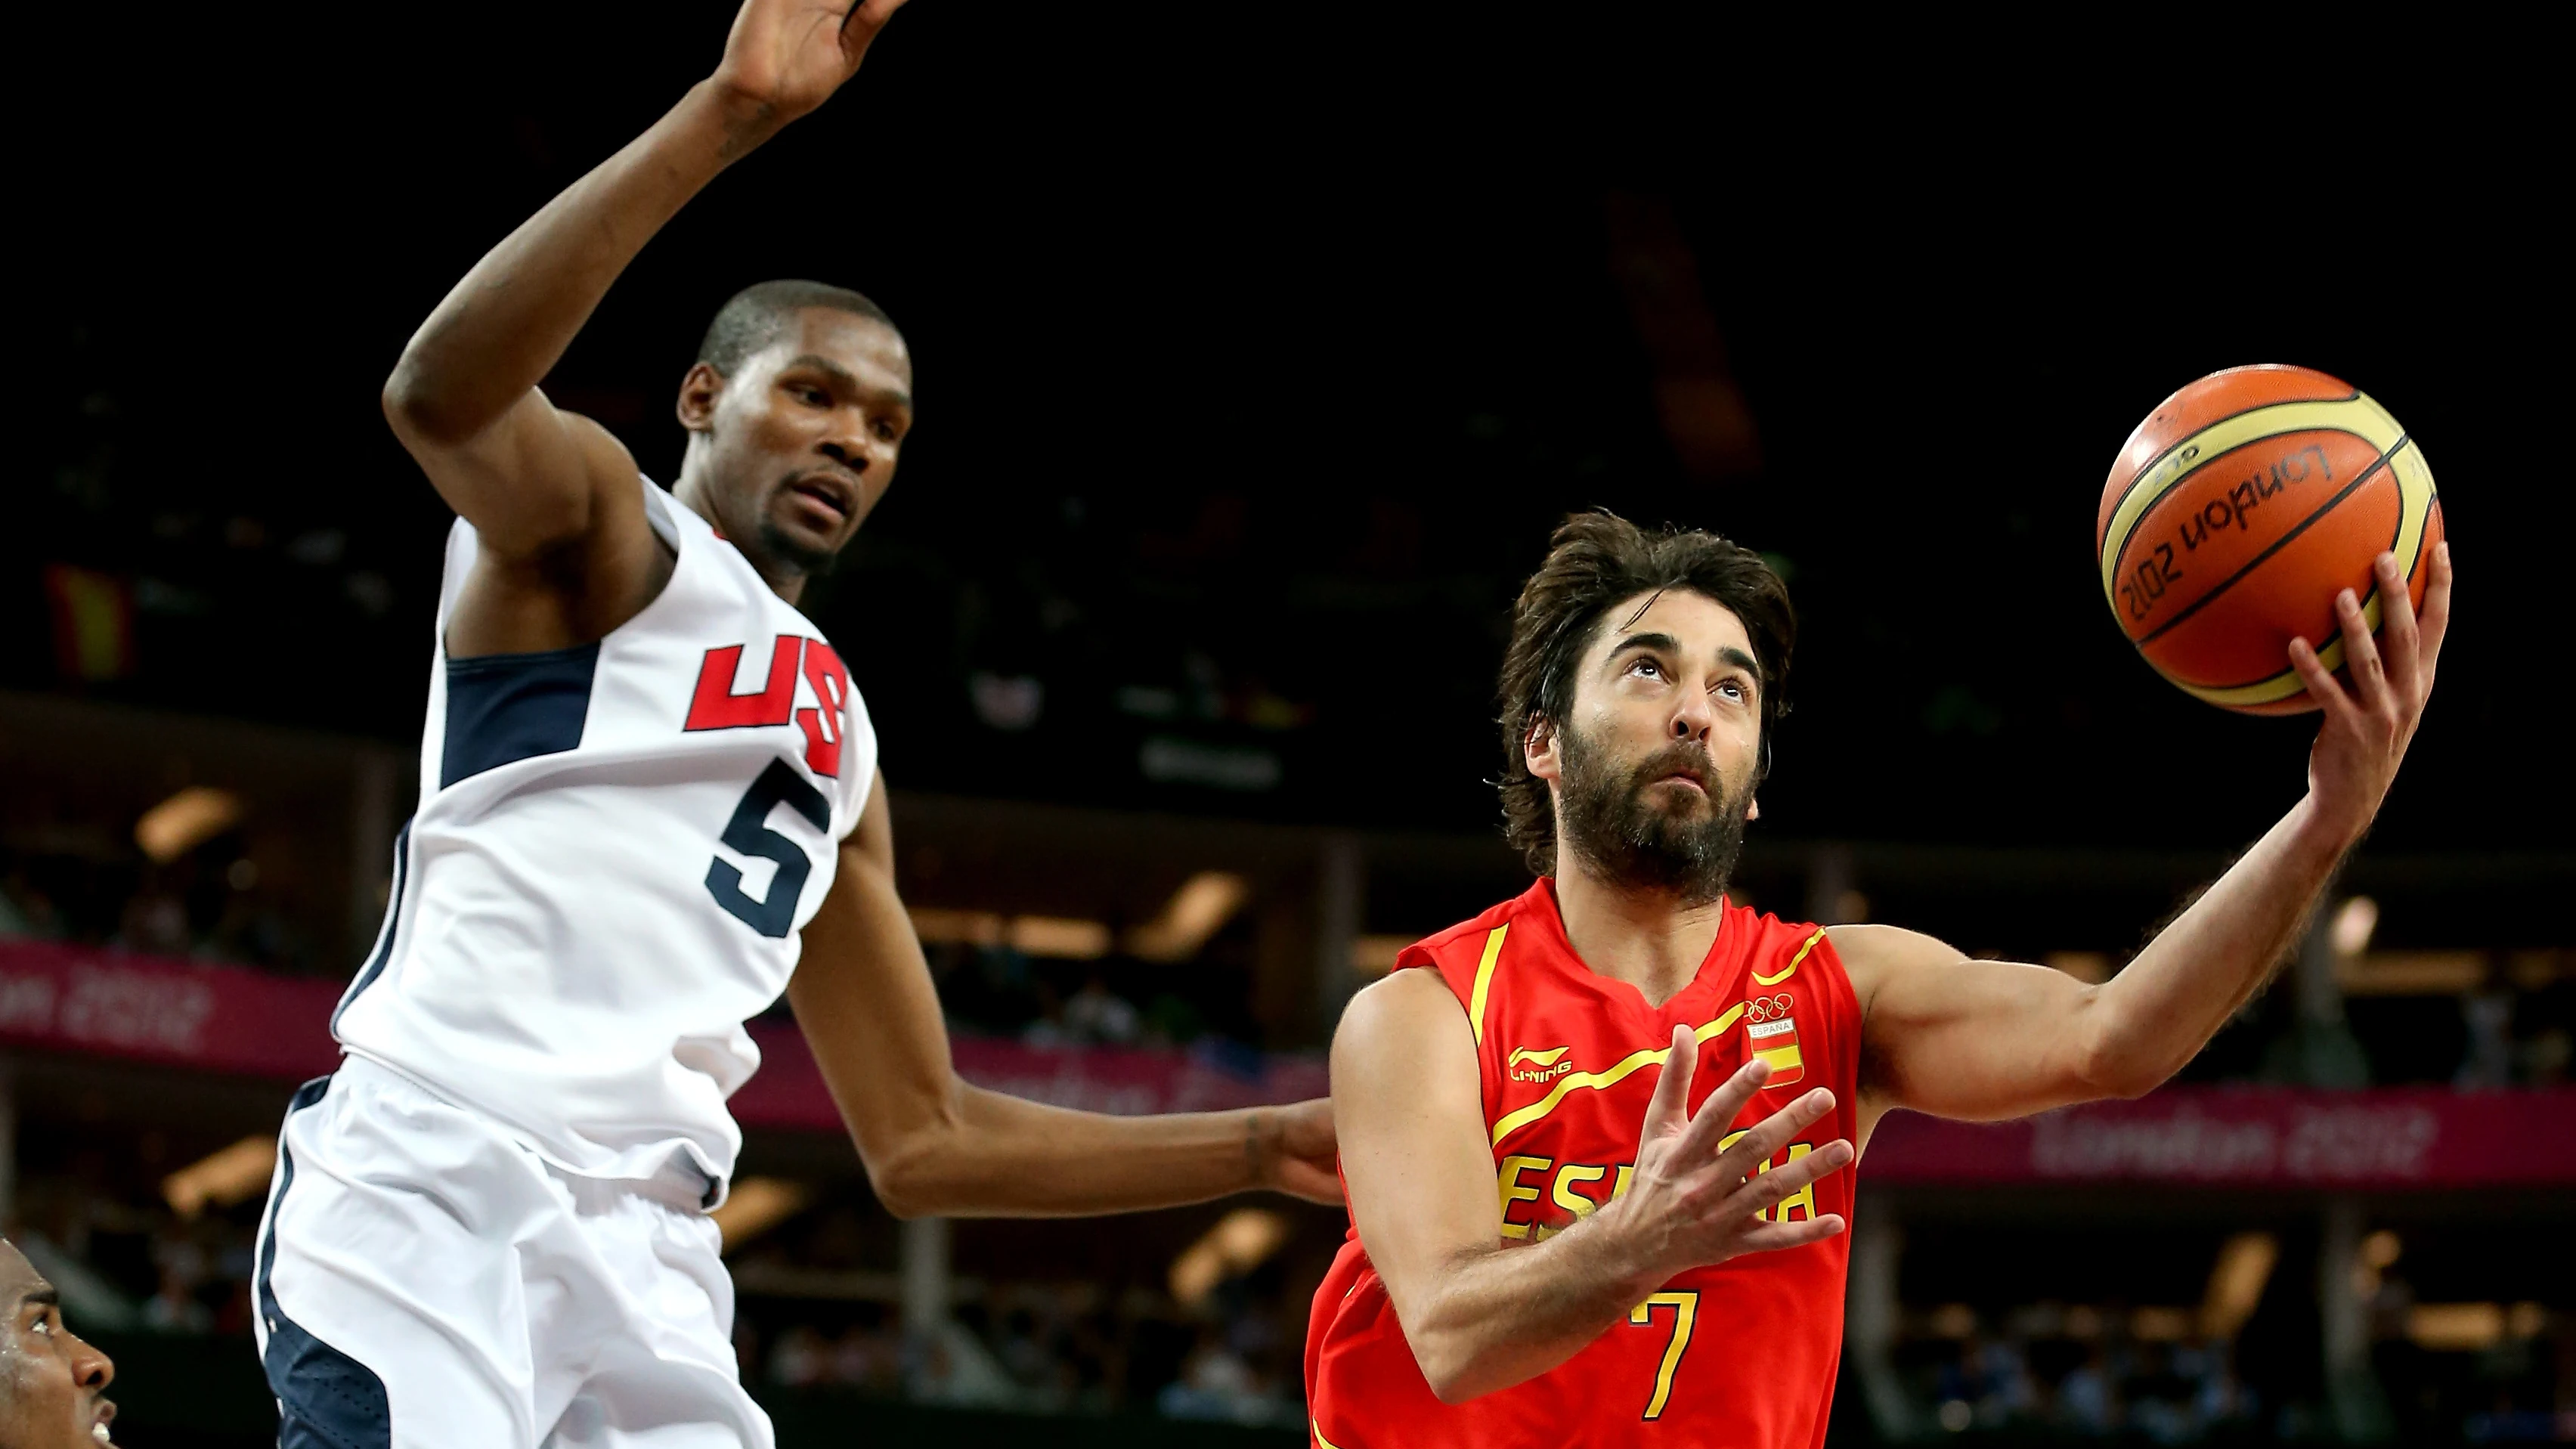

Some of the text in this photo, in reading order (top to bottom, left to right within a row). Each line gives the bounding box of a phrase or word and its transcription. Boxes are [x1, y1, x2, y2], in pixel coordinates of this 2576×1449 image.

[2121, 444, 2333, 621] London 2012
[704, 756, 831, 938] 5
[1509, 1060, 1572, 1083] LI-NING
[1629, 1290, 1701, 1422] 7
